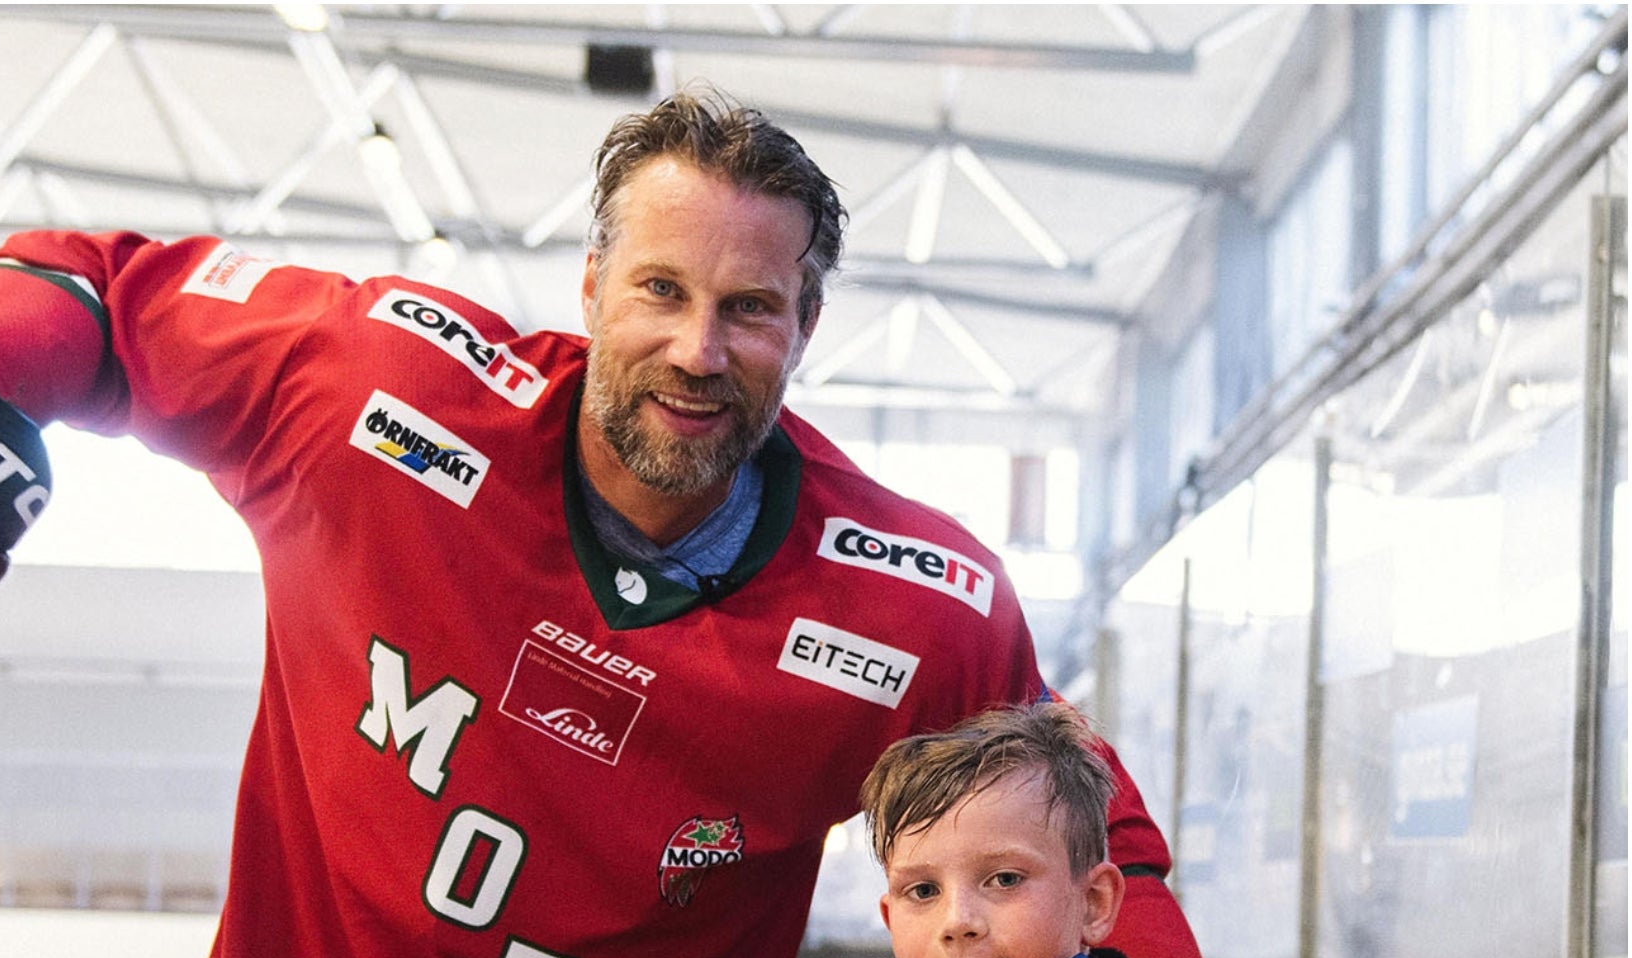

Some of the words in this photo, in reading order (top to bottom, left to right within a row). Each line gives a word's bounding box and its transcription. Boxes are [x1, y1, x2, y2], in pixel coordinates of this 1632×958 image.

[391, 299, 534, 391] coreIT
[365, 408, 479, 486] ÖRNFRAKT
[834, 528, 984, 596] coreIT
[531, 620, 657, 687] BAUER
[525, 708, 615, 753] Linde
[668, 848, 740, 868] MODO
